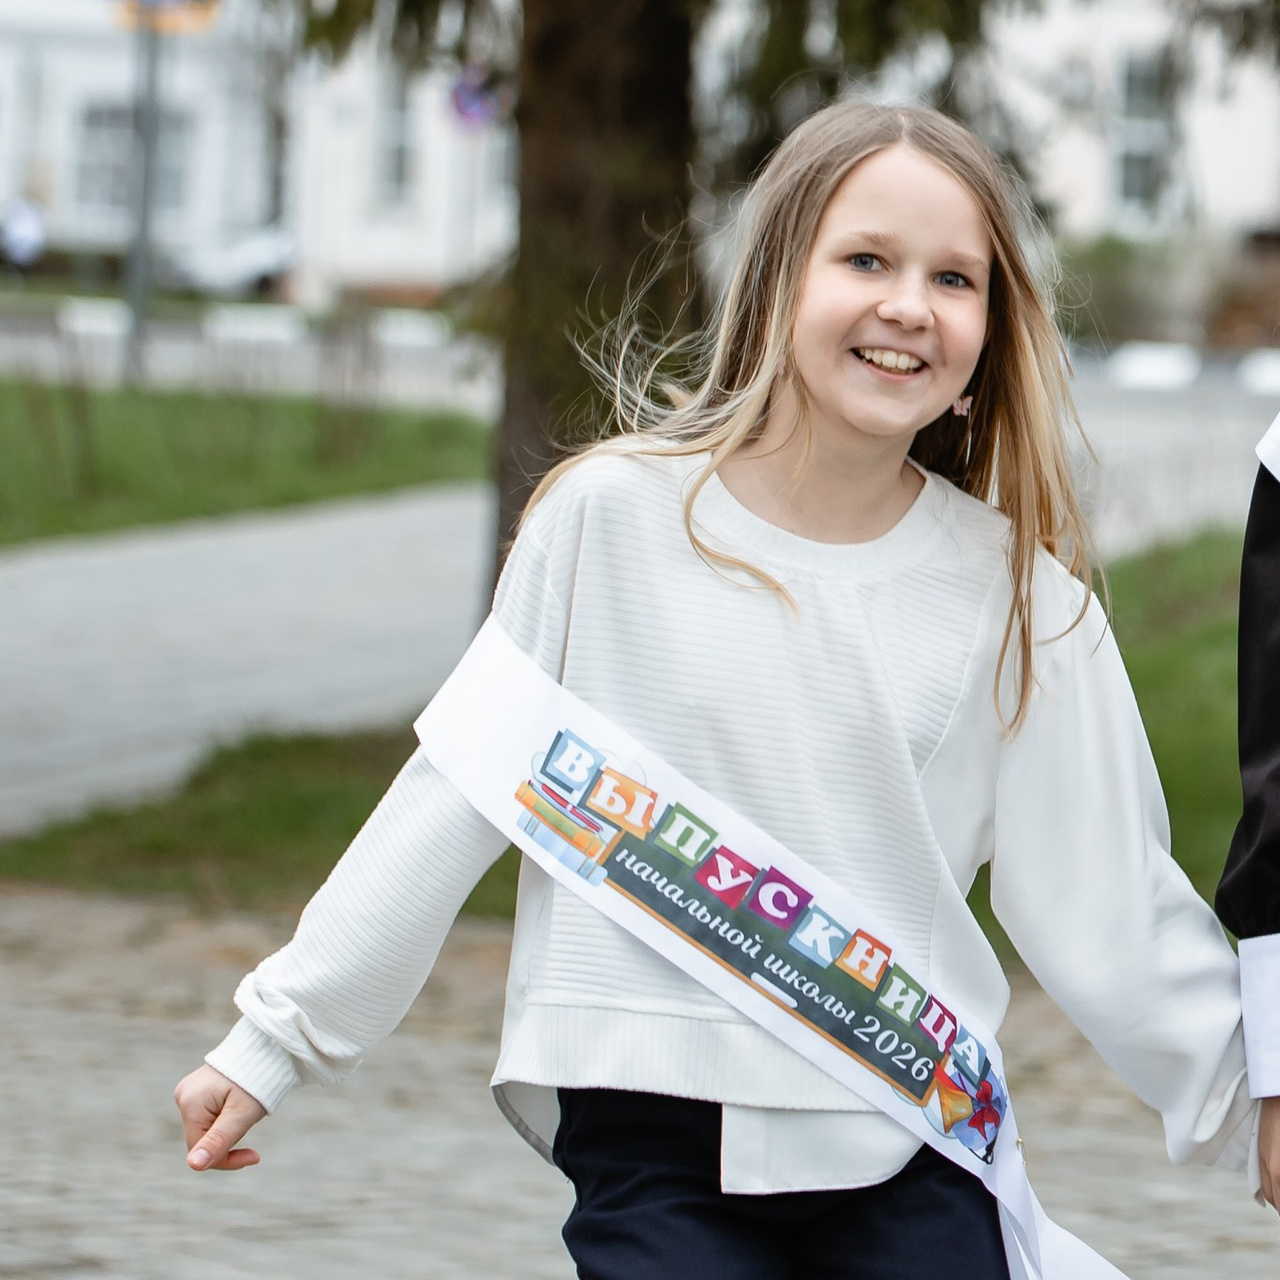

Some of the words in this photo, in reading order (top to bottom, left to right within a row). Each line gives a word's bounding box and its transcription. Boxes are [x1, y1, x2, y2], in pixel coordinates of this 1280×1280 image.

[553, 738, 980, 1077] ВЫПУСКНИЦА
[614, 848, 765, 960] начальной
[763, 953, 856, 1025] школы
[853, 1015, 935, 1082] 2026
